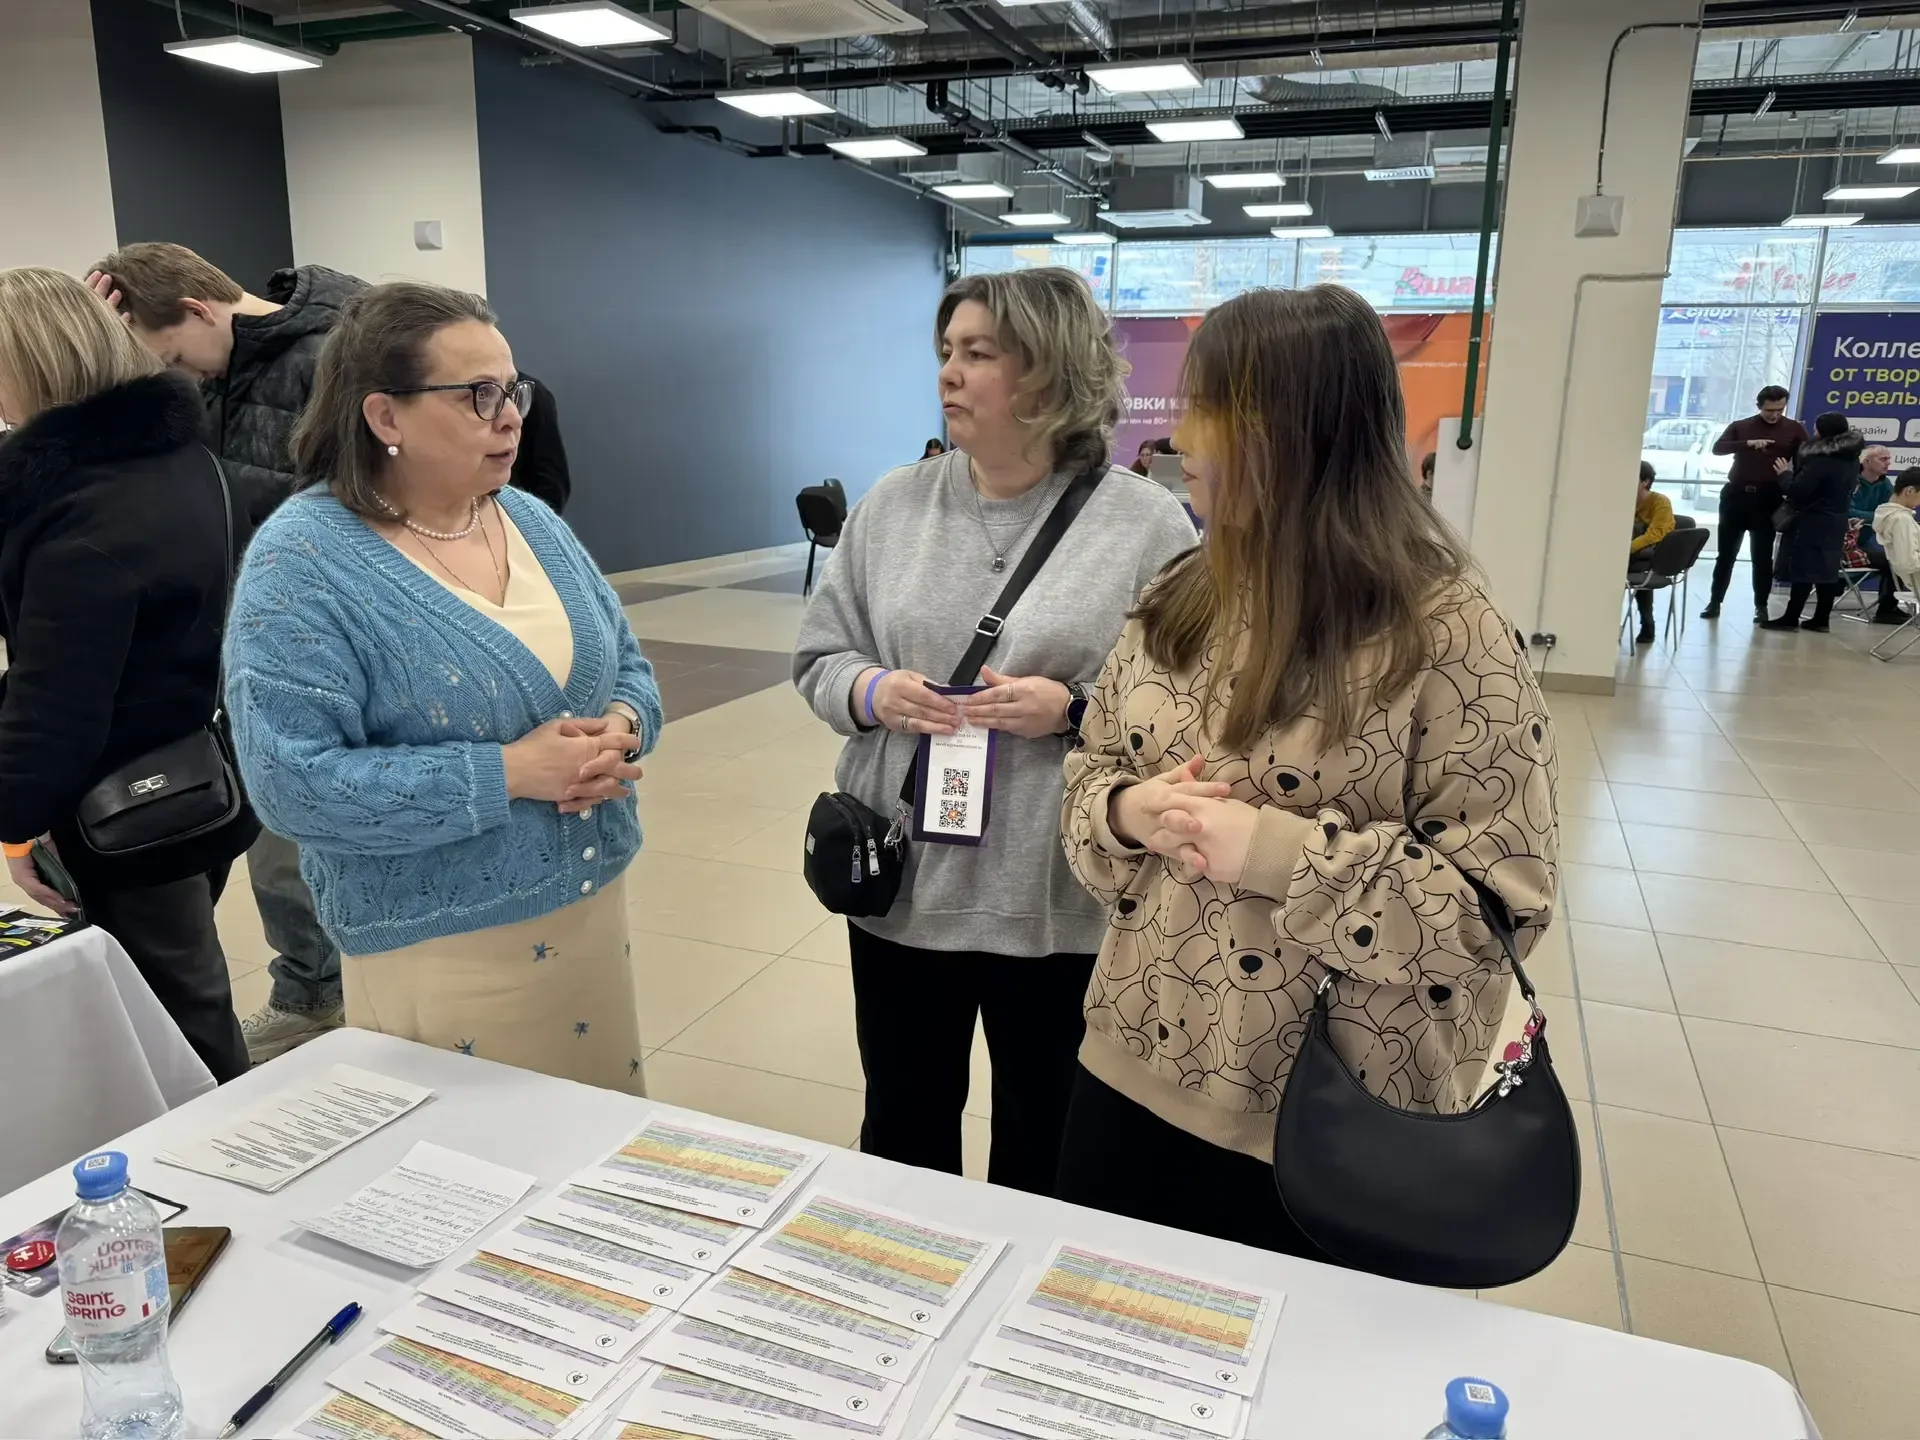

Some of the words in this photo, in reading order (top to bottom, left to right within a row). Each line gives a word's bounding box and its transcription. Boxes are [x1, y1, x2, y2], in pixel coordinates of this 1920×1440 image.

[1834, 336, 1920, 358] Колле
[1830, 367, 1858, 382] от
[1863, 367, 1920, 388] твор
[1122, 397, 1166, 410] ОВКИ
[1826, 390, 1840, 404] с
[1844, 390, 1920, 409] реаль
